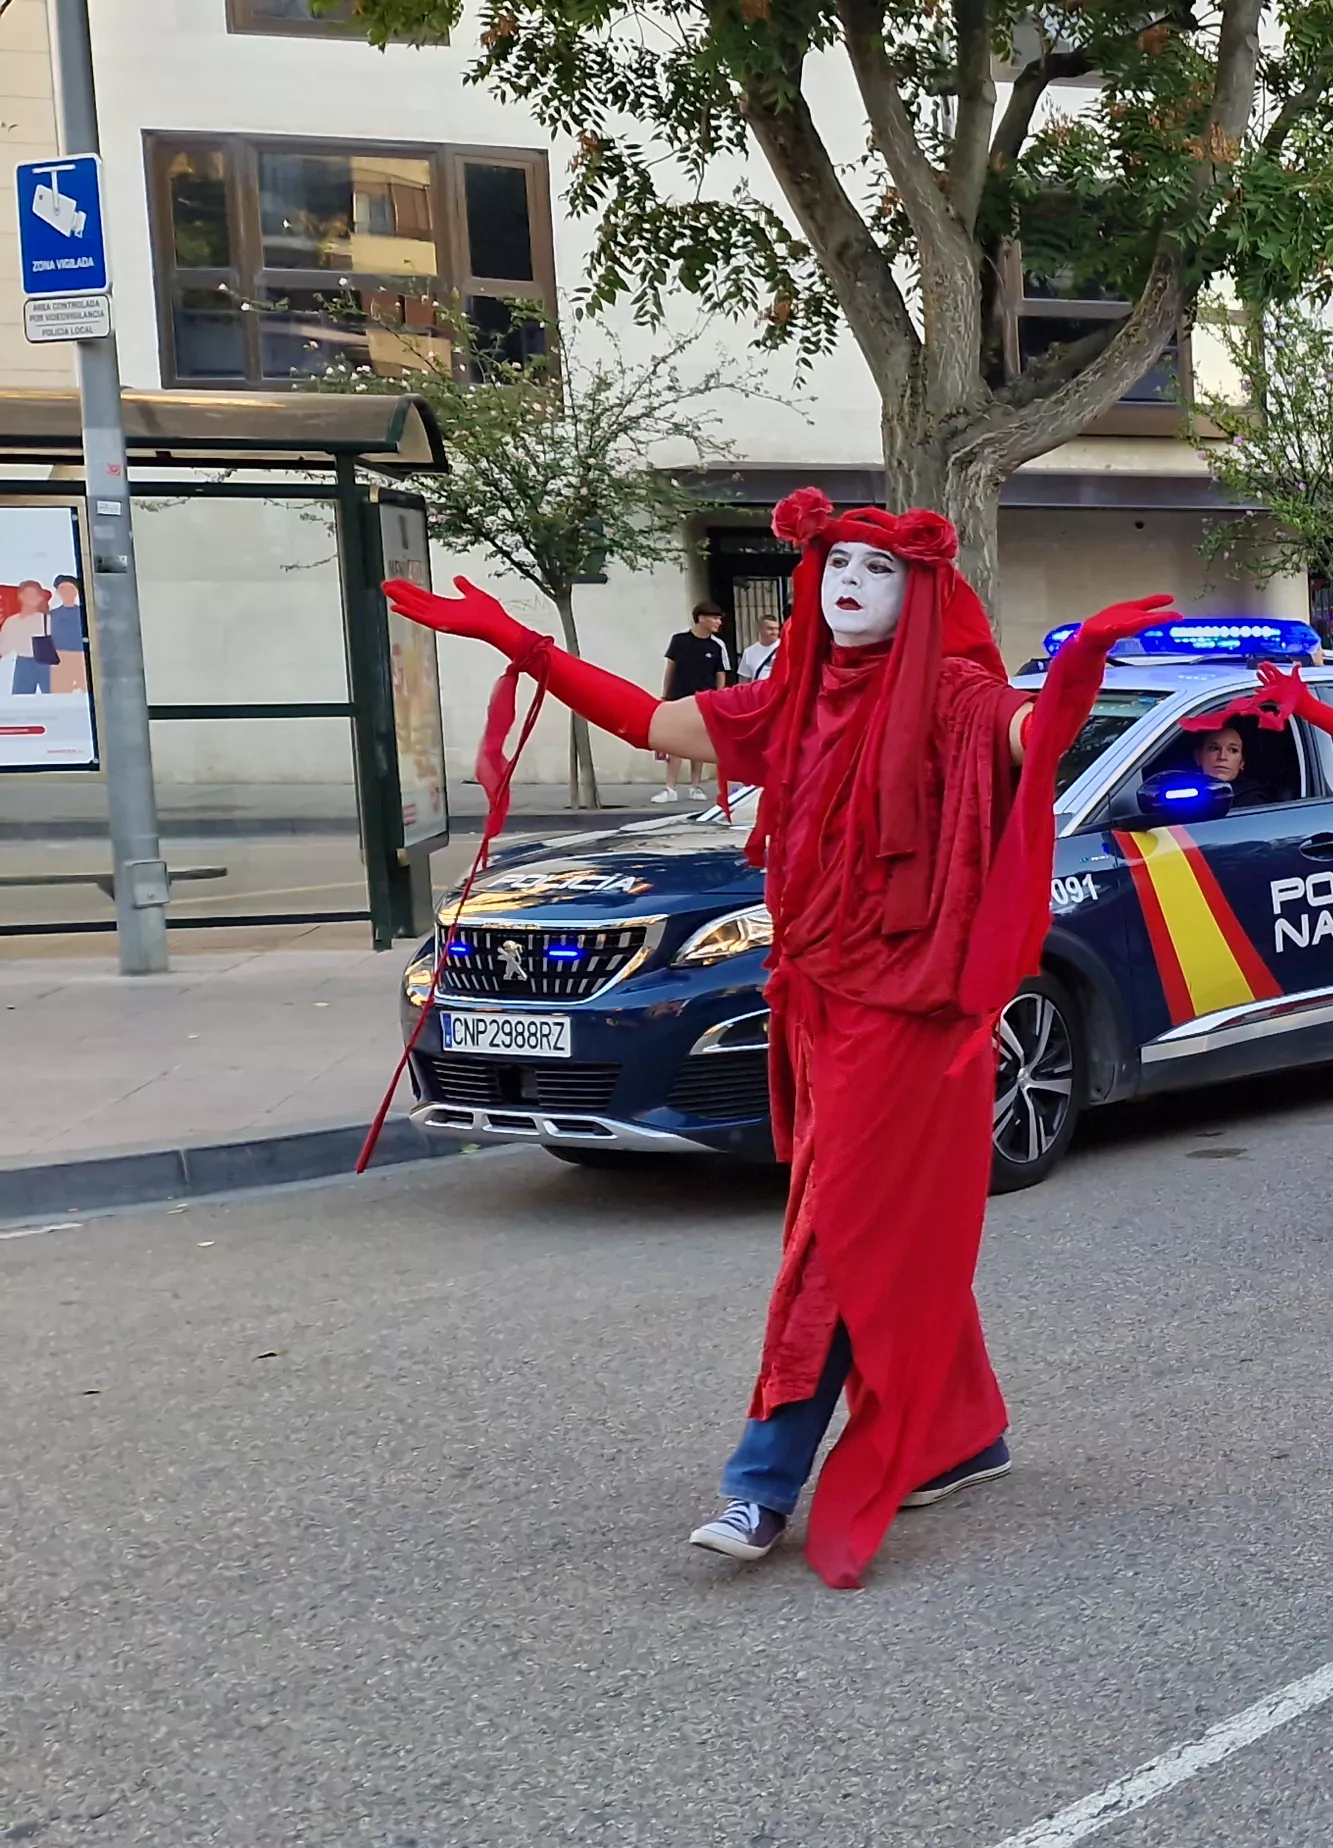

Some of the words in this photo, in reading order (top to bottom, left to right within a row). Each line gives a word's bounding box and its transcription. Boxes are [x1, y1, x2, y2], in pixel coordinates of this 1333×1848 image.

[32, 260, 56, 272] ZONA
[56, 257, 94, 270] VIGILADA
[52, 299, 100, 311] CONTROLADA
[70, 326, 94, 334] LOCAL
[1051, 873, 1098, 905] 091
[452, 1017, 566, 1051] CNP2988RZ
